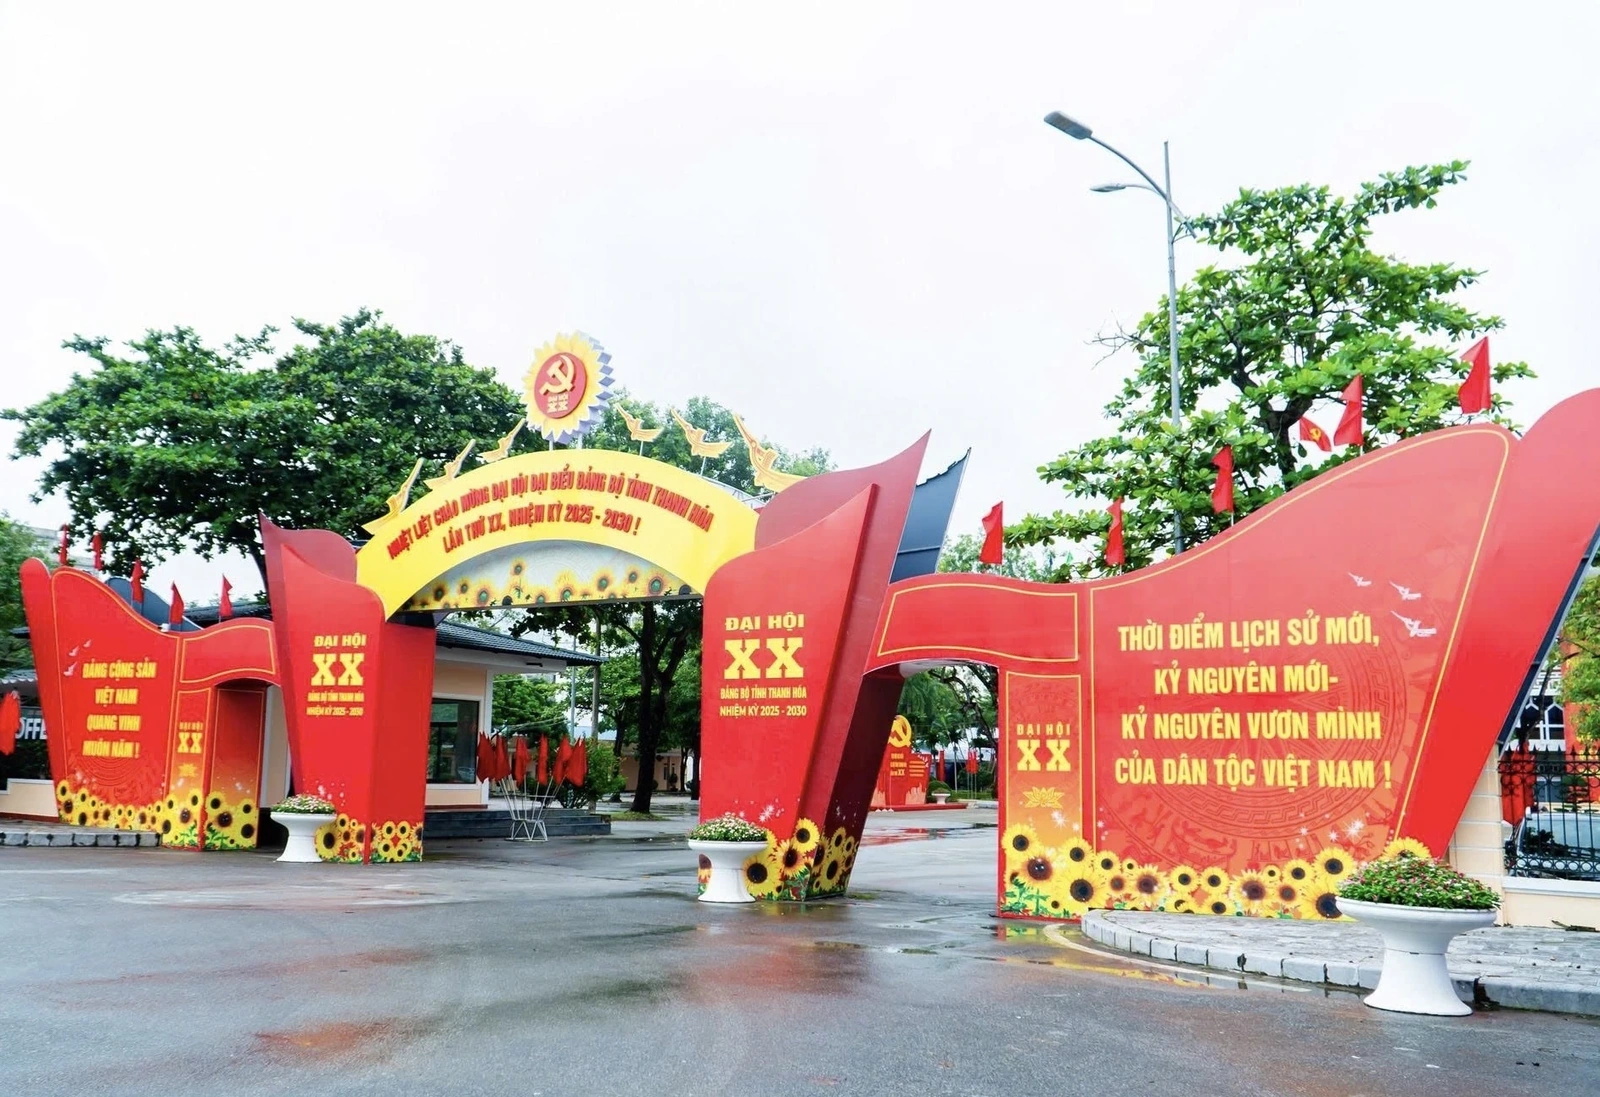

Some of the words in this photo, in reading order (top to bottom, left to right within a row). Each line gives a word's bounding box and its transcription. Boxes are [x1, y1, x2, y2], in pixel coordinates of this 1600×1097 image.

[387, 528, 414, 559] NHIỆT
[413, 514, 432, 539] LIỆT
[434, 500, 459, 526] CHÀO
[460, 486, 490, 512] MỪNG
[492, 480, 508, 502] ĐẠI
[511, 473, 528, 498] HỘI
[530, 473, 548, 494] ĐẠI
[550, 464, 574, 490] BIỂU
[576, 466, 606, 491] ĐẢNG
[608, 472, 625, 498] BỘ
[626, 474, 653, 502] TỈNH
[652, 486, 692, 518] THANH
[687, 505, 714, 532] HÓA
[443, 526, 464, 553] LẦN
[465, 516, 486, 541] THỨ
[488, 513, 506, 532] XX,
[509, 502, 545, 527] NHIỆM
[547, 500, 563, 522] KỲ
[564, 504, 594, 524] 2025
[602, 508, 633, 533] 2030
[633, 517, 642, 536] !
[725, 616, 760, 632] ĐẠI
[768, 612, 804, 631] HỘI
[1118, 618, 1163, 651] THỜI
[1170, 612, 1224, 650] ĐIỂM
[1230, 619, 1280, 653] LỊCH
[1287, 609, 1320, 646] SỬ
[1325, 610, 1380, 647] MỚI,
[314, 635, 338, 649] ĐẠI
[342, 632, 367, 648] HỘI
[82, 658, 108, 678] ĐẢNG
[109, 660, 134, 682] CỘNG
[136, 657, 157, 678] SẢN
[311, 652, 365, 686] XX
[724, 637, 804, 680] XX
[1154, 660, 1182, 694] KỶ
[1188, 660, 1276, 694] NGUYÊN
[95, 686, 115, 707] VIỆT
[116, 688, 138, 704] NAM
[720, 684, 739, 700] ĐẢNG
[740, 686, 750, 701] BỘ
[751, 684, 766, 698] TỈNH
[768, 687, 790, 698] THANH
[792, 685, 806, 698] HÓA
[86, 714, 118, 732] QUANG
[118, 716, 142, 731] VINH
[720, 703, 746, 718] NHIỆM
[748, 703, 759, 716] KỲ
[760, 706, 780, 716] 2025
[786, 706, 806, 716] 2030
[1122, 705, 1148, 740] KỶ
[1154, 707, 1240, 740] NGUYÊN
[1246, 709, 1309, 740] VƯƠN
[1316, 706, 1382, 740] MÌNH
[1046, 721, 1070, 738] HỘI
[82, 738, 110, 756] MUÔN
[111, 739, 134, 758] NĂM
[134, 742, 140, 758] !
[178, 732, 202, 754] XX
[1017, 739, 1071, 772] XX
[1115, 750, 1157, 784] CỦA
[1162, 753, 1208, 785] DÂN
[1214, 754, 1256, 792] TỘC
[1262, 754, 1311, 792] VIỆT
[1318, 760, 1375, 788] NAM
[1384, 761, 1392, 788] !
